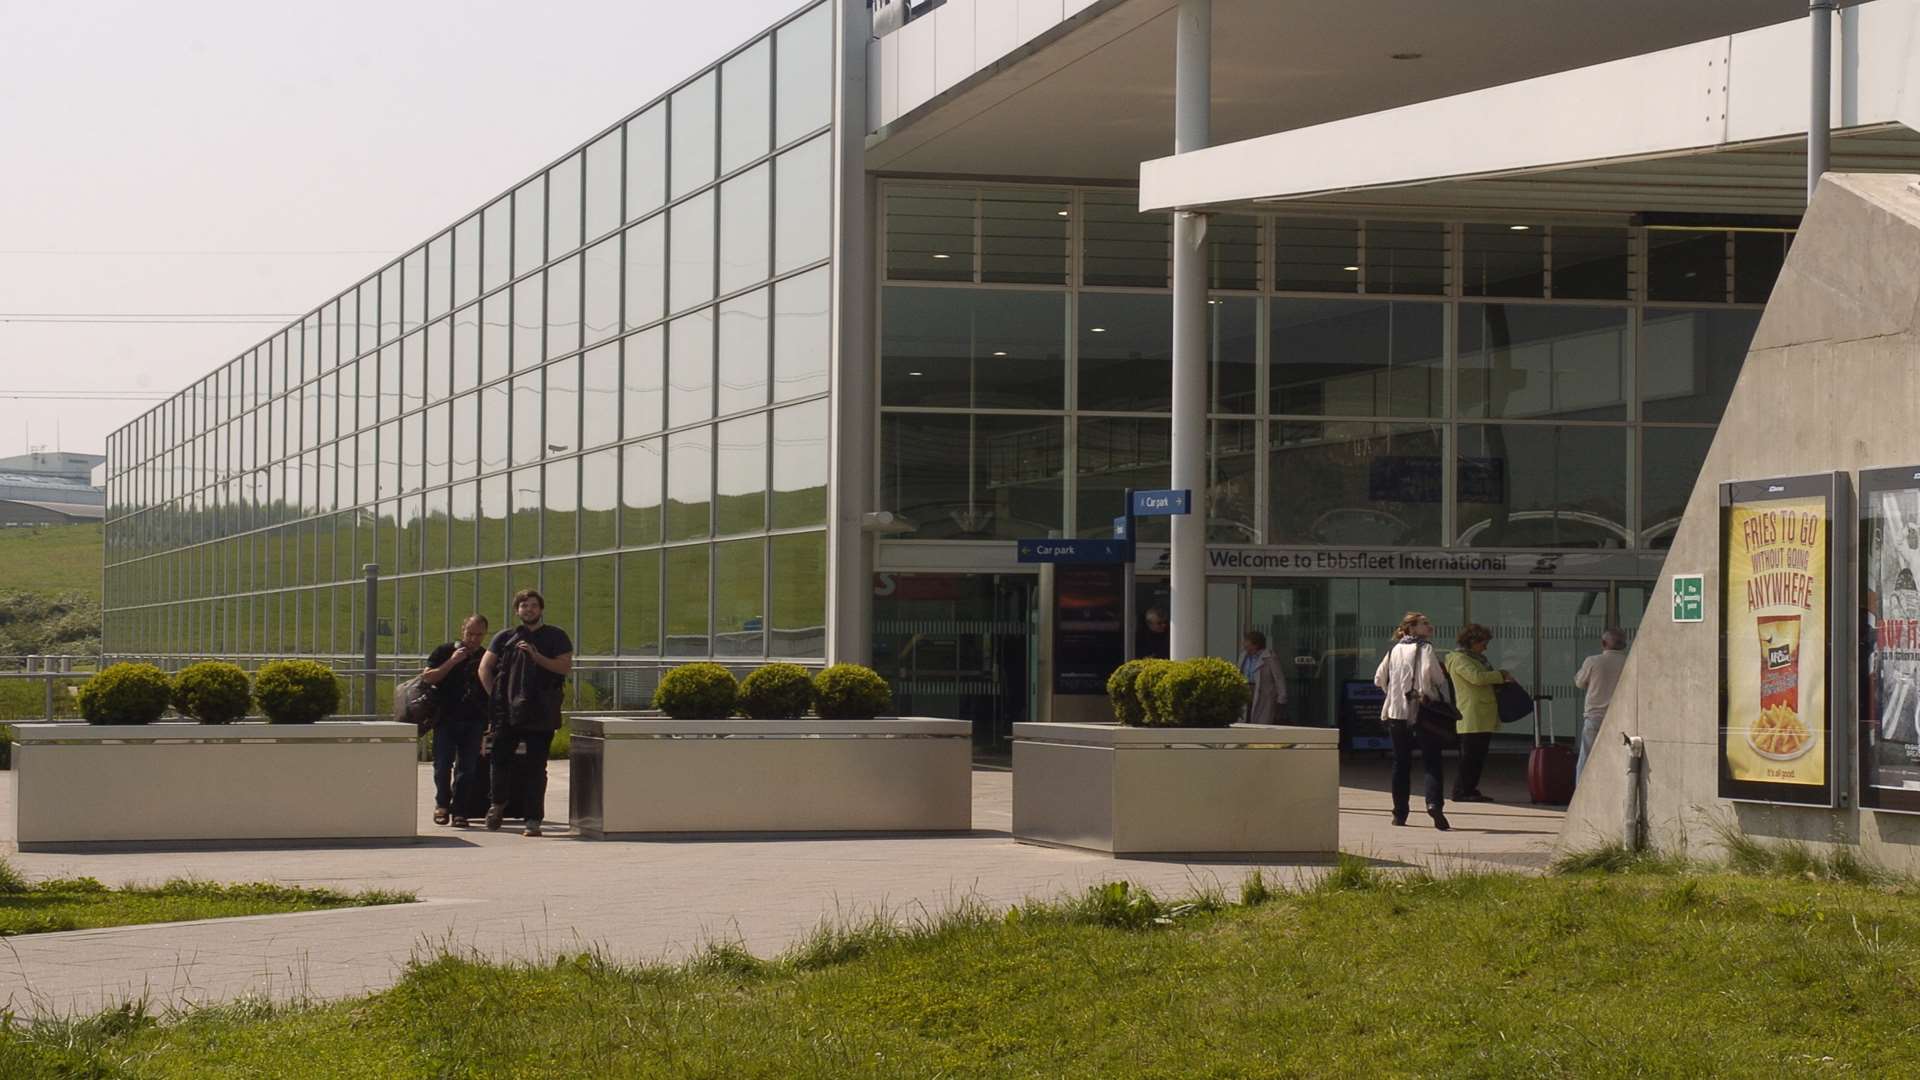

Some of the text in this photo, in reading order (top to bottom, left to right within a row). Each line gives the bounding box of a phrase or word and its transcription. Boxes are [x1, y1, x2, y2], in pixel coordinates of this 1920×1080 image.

[1146, 496, 1156, 507] Car
[1744, 510, 1818, 552] FRIES TO GO
[1036, 545, 1075, 556] Car park
[1210, 551, 1507, 571] Welcome to Ebbsfleet International
[1752, 547, 1808, 574] WITHOUT GOING
[1746, 572, 1814, 612] ANYWHERE
